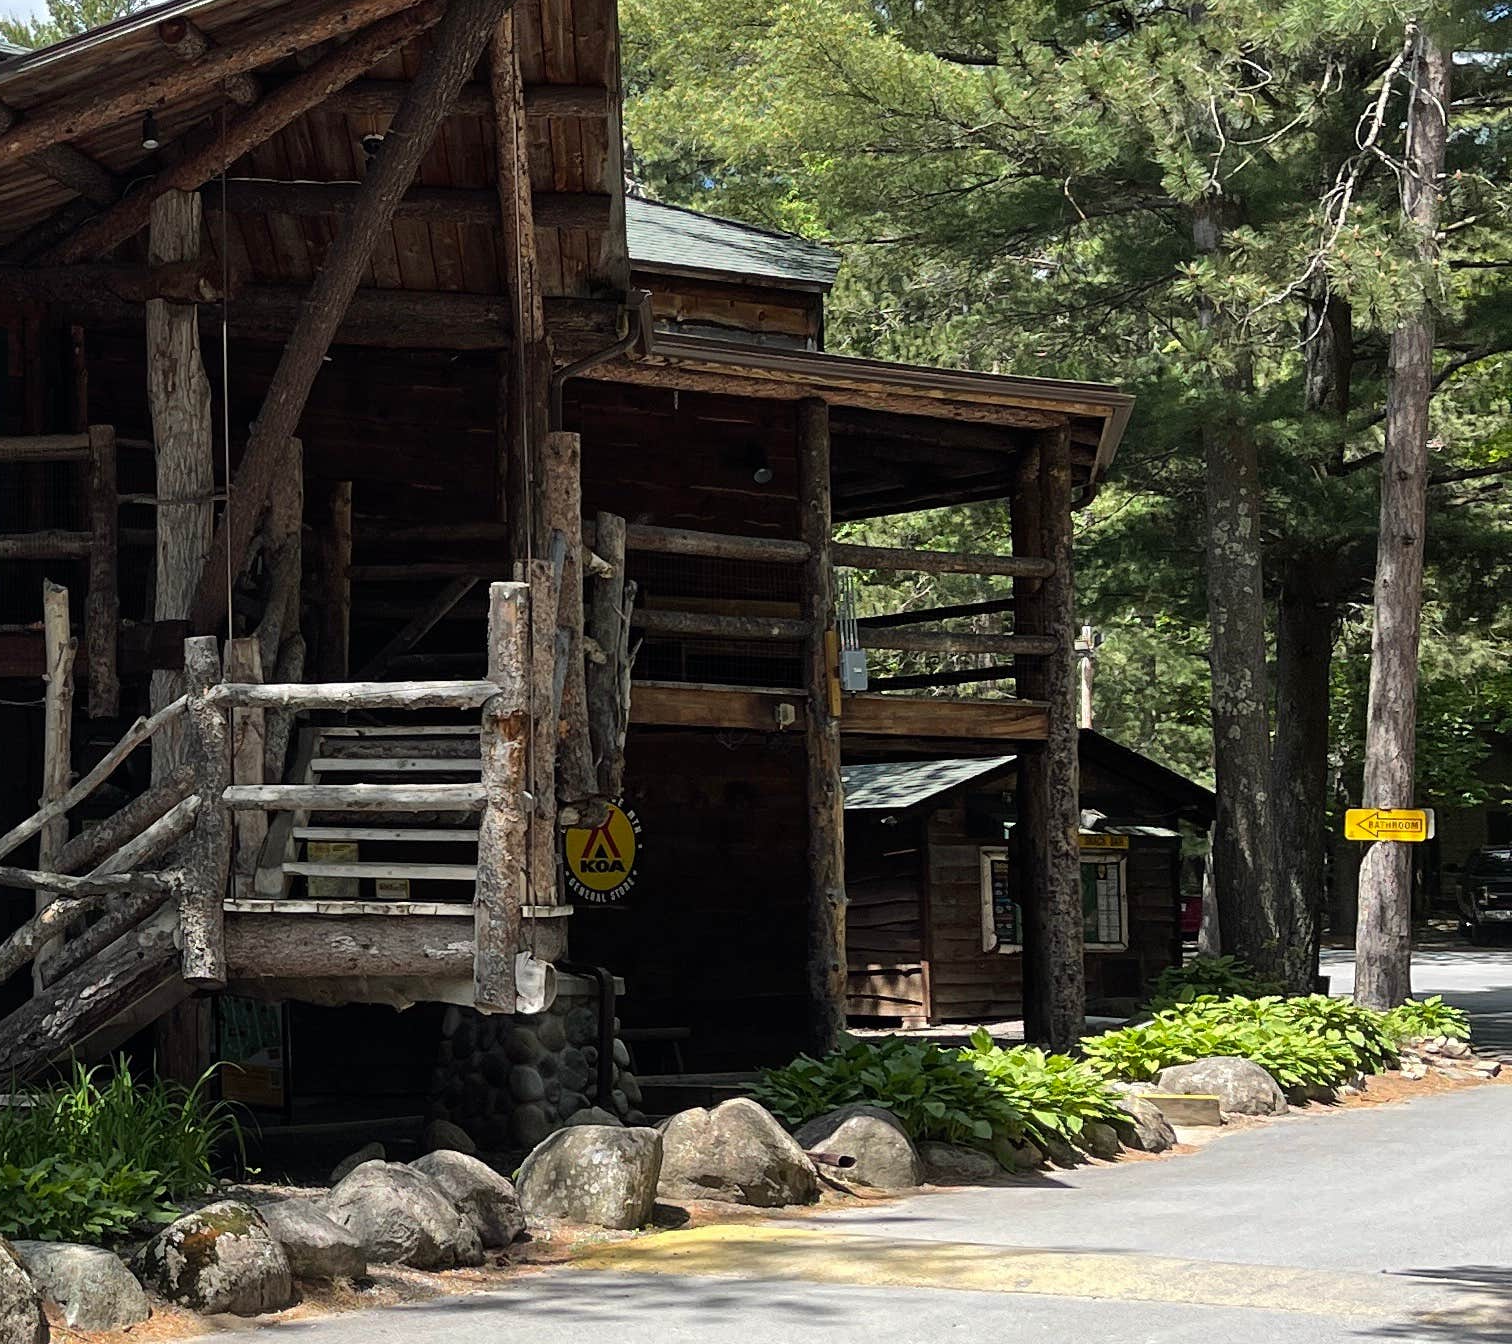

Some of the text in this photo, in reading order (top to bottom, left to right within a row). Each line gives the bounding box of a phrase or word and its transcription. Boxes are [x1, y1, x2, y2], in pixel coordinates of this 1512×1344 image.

[1368, 821, 1419, 829] BATHROOM
[580, 859, 627, 873] KOA
[568, 876, 636, 903] GENERAL STORE
